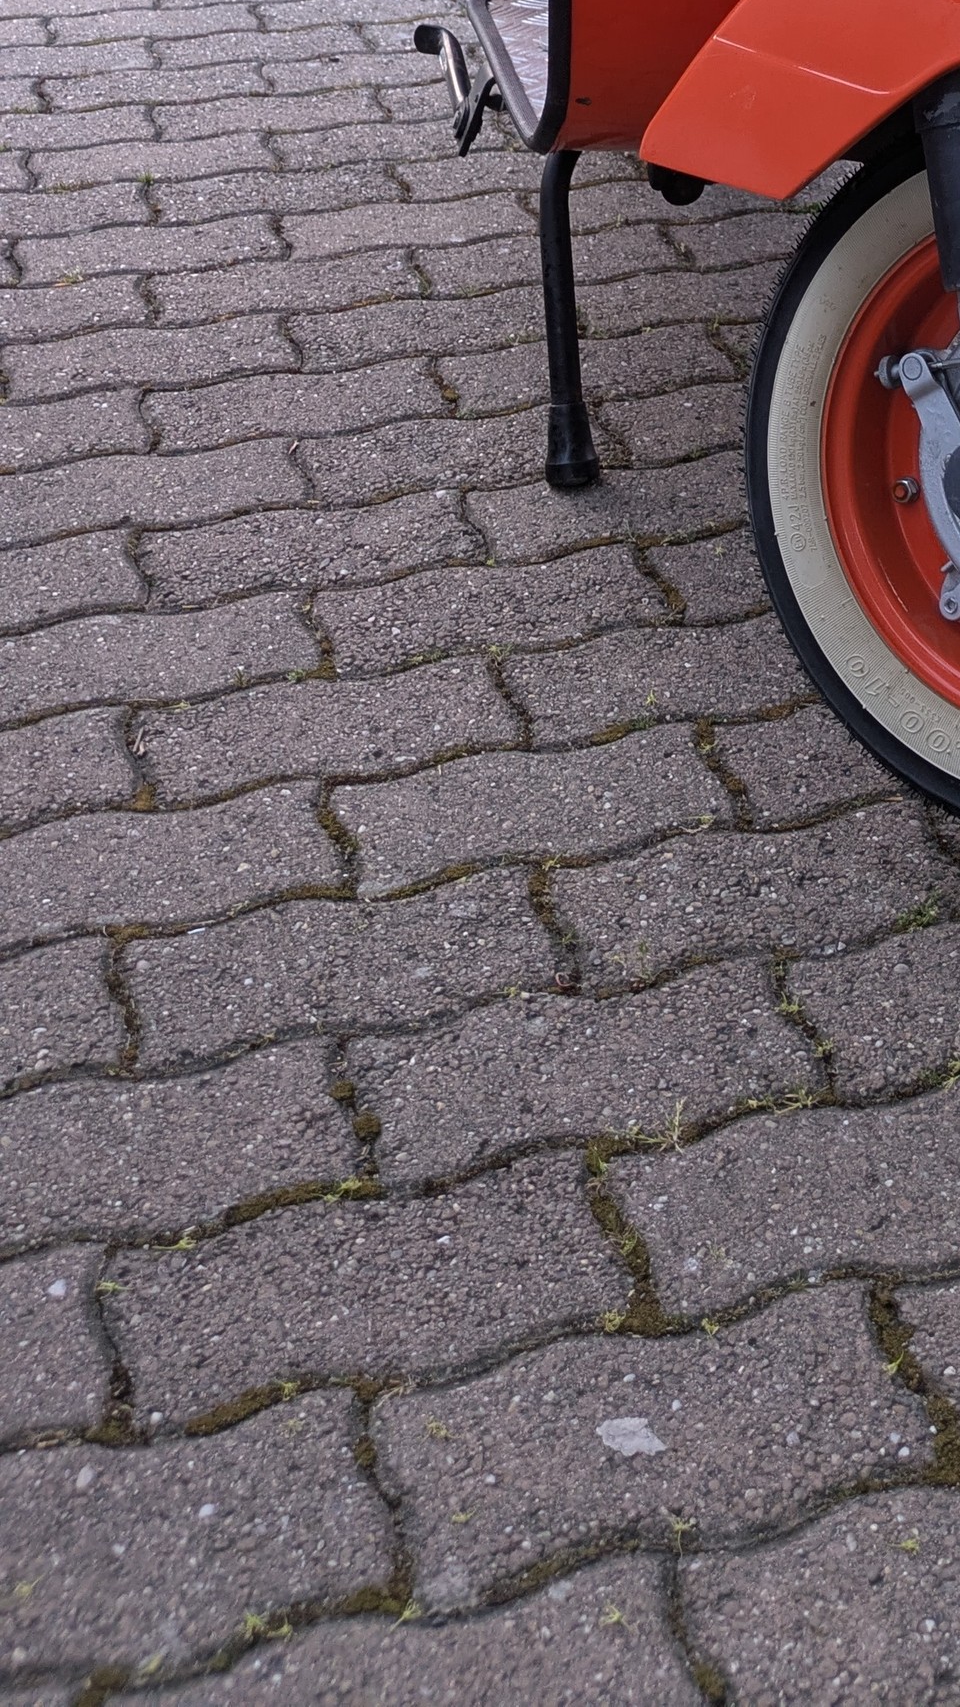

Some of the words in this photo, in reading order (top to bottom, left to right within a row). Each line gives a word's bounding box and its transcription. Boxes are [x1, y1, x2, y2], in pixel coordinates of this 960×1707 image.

[791, 344, 804, 369] TYPE
[785, 370, 798, 395] TUBE
[780, 411, 790, 443] RANGE
[779, 447, 788, 473] LOAD
